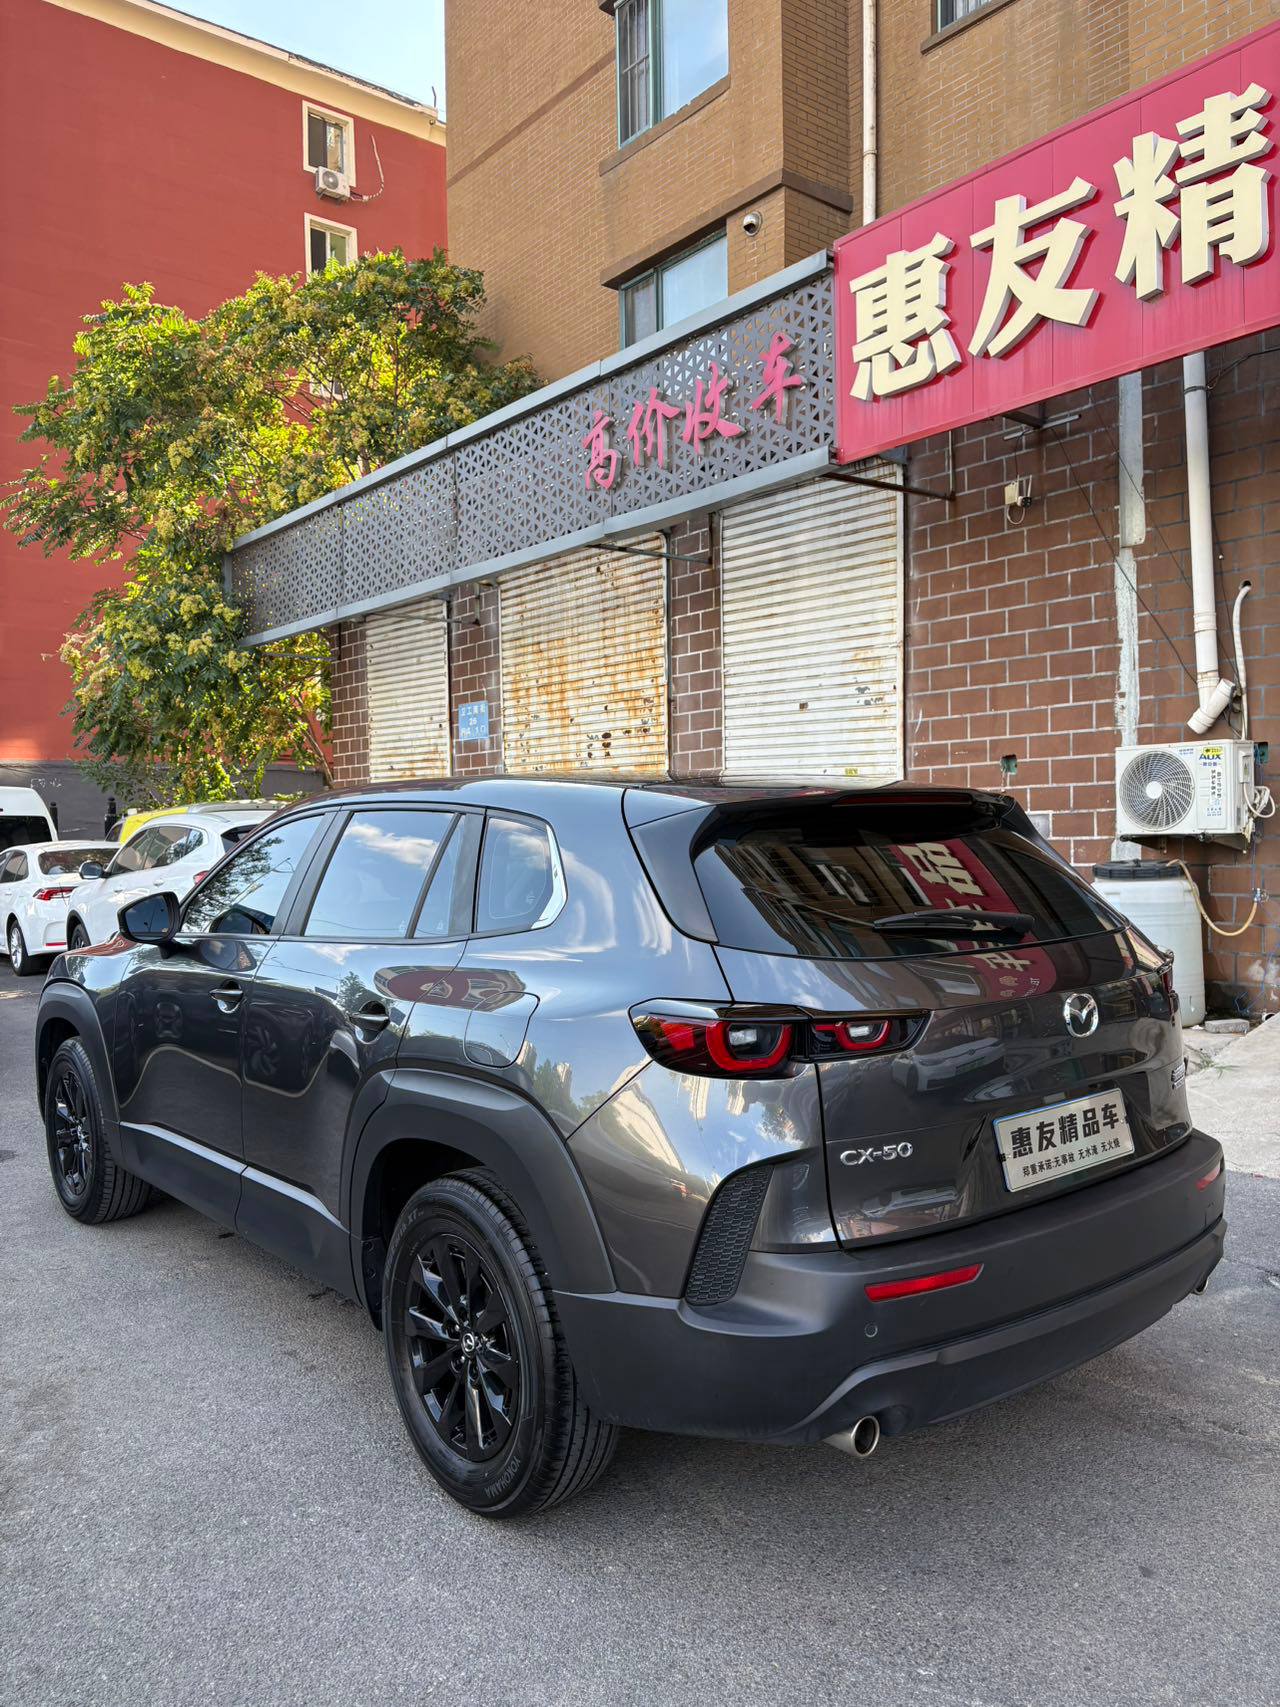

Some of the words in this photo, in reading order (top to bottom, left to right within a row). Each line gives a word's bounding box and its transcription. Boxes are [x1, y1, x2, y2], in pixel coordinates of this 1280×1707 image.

[849, 82, 1273, 401] 惠友精
[583, 331, 807, 491] 高价收车
[1199, 753, 1222, 761] AUX
[840, 1142, 914, 1166] CX-50
[1010, 1103, 1120, 1159] 惠友精品车
[484, 1455, 521, 1499] YOKOHAMA
